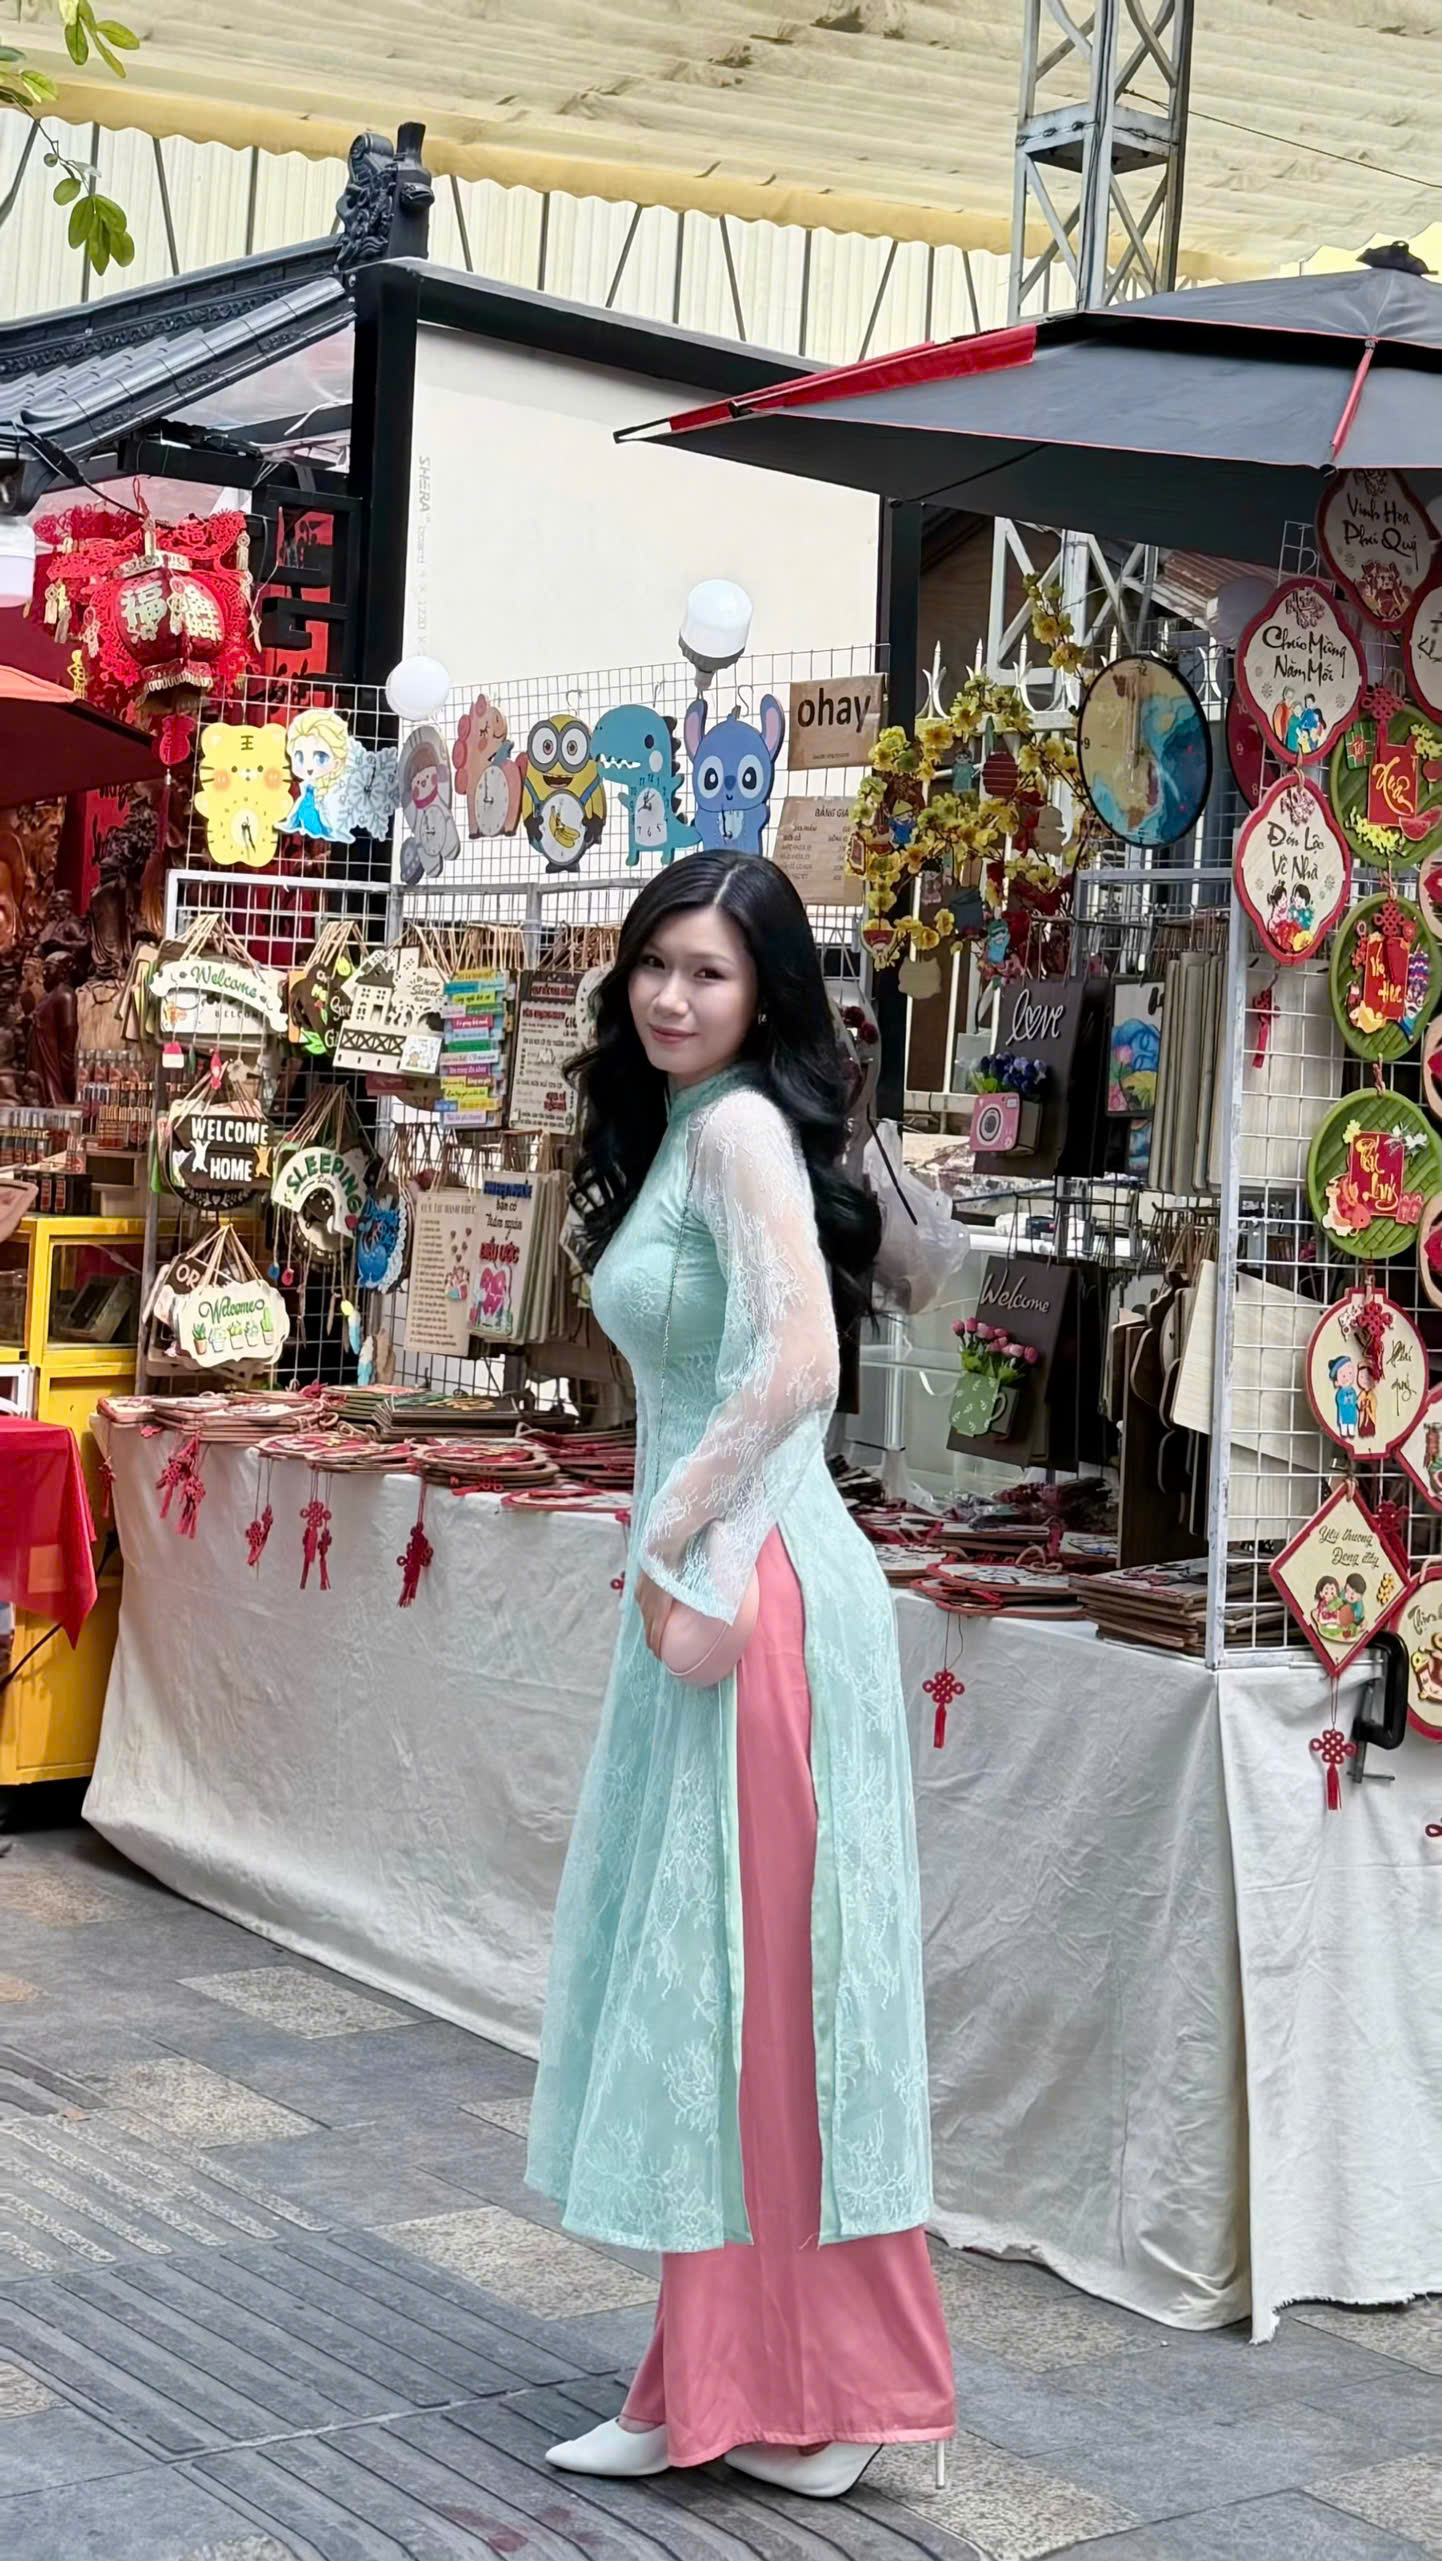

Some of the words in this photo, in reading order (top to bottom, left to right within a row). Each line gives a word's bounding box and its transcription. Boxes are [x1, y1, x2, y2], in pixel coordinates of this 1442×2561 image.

[418, 456, 431, 512] SHERA
[1262, 625, 1308, 651] Chúc
[796, 687, 873, 733] ohay
[190, 965, 258, 998] Welcome
[191, 1118, 269, 1146] WELCOME
[210, 1157, 253, 1182] HOME
[286, 1153, 363, 1213] SLEEPING
[979, 1267, 1050, 1313] Welcome
[198, 1295, 264, 1323] Welcome
